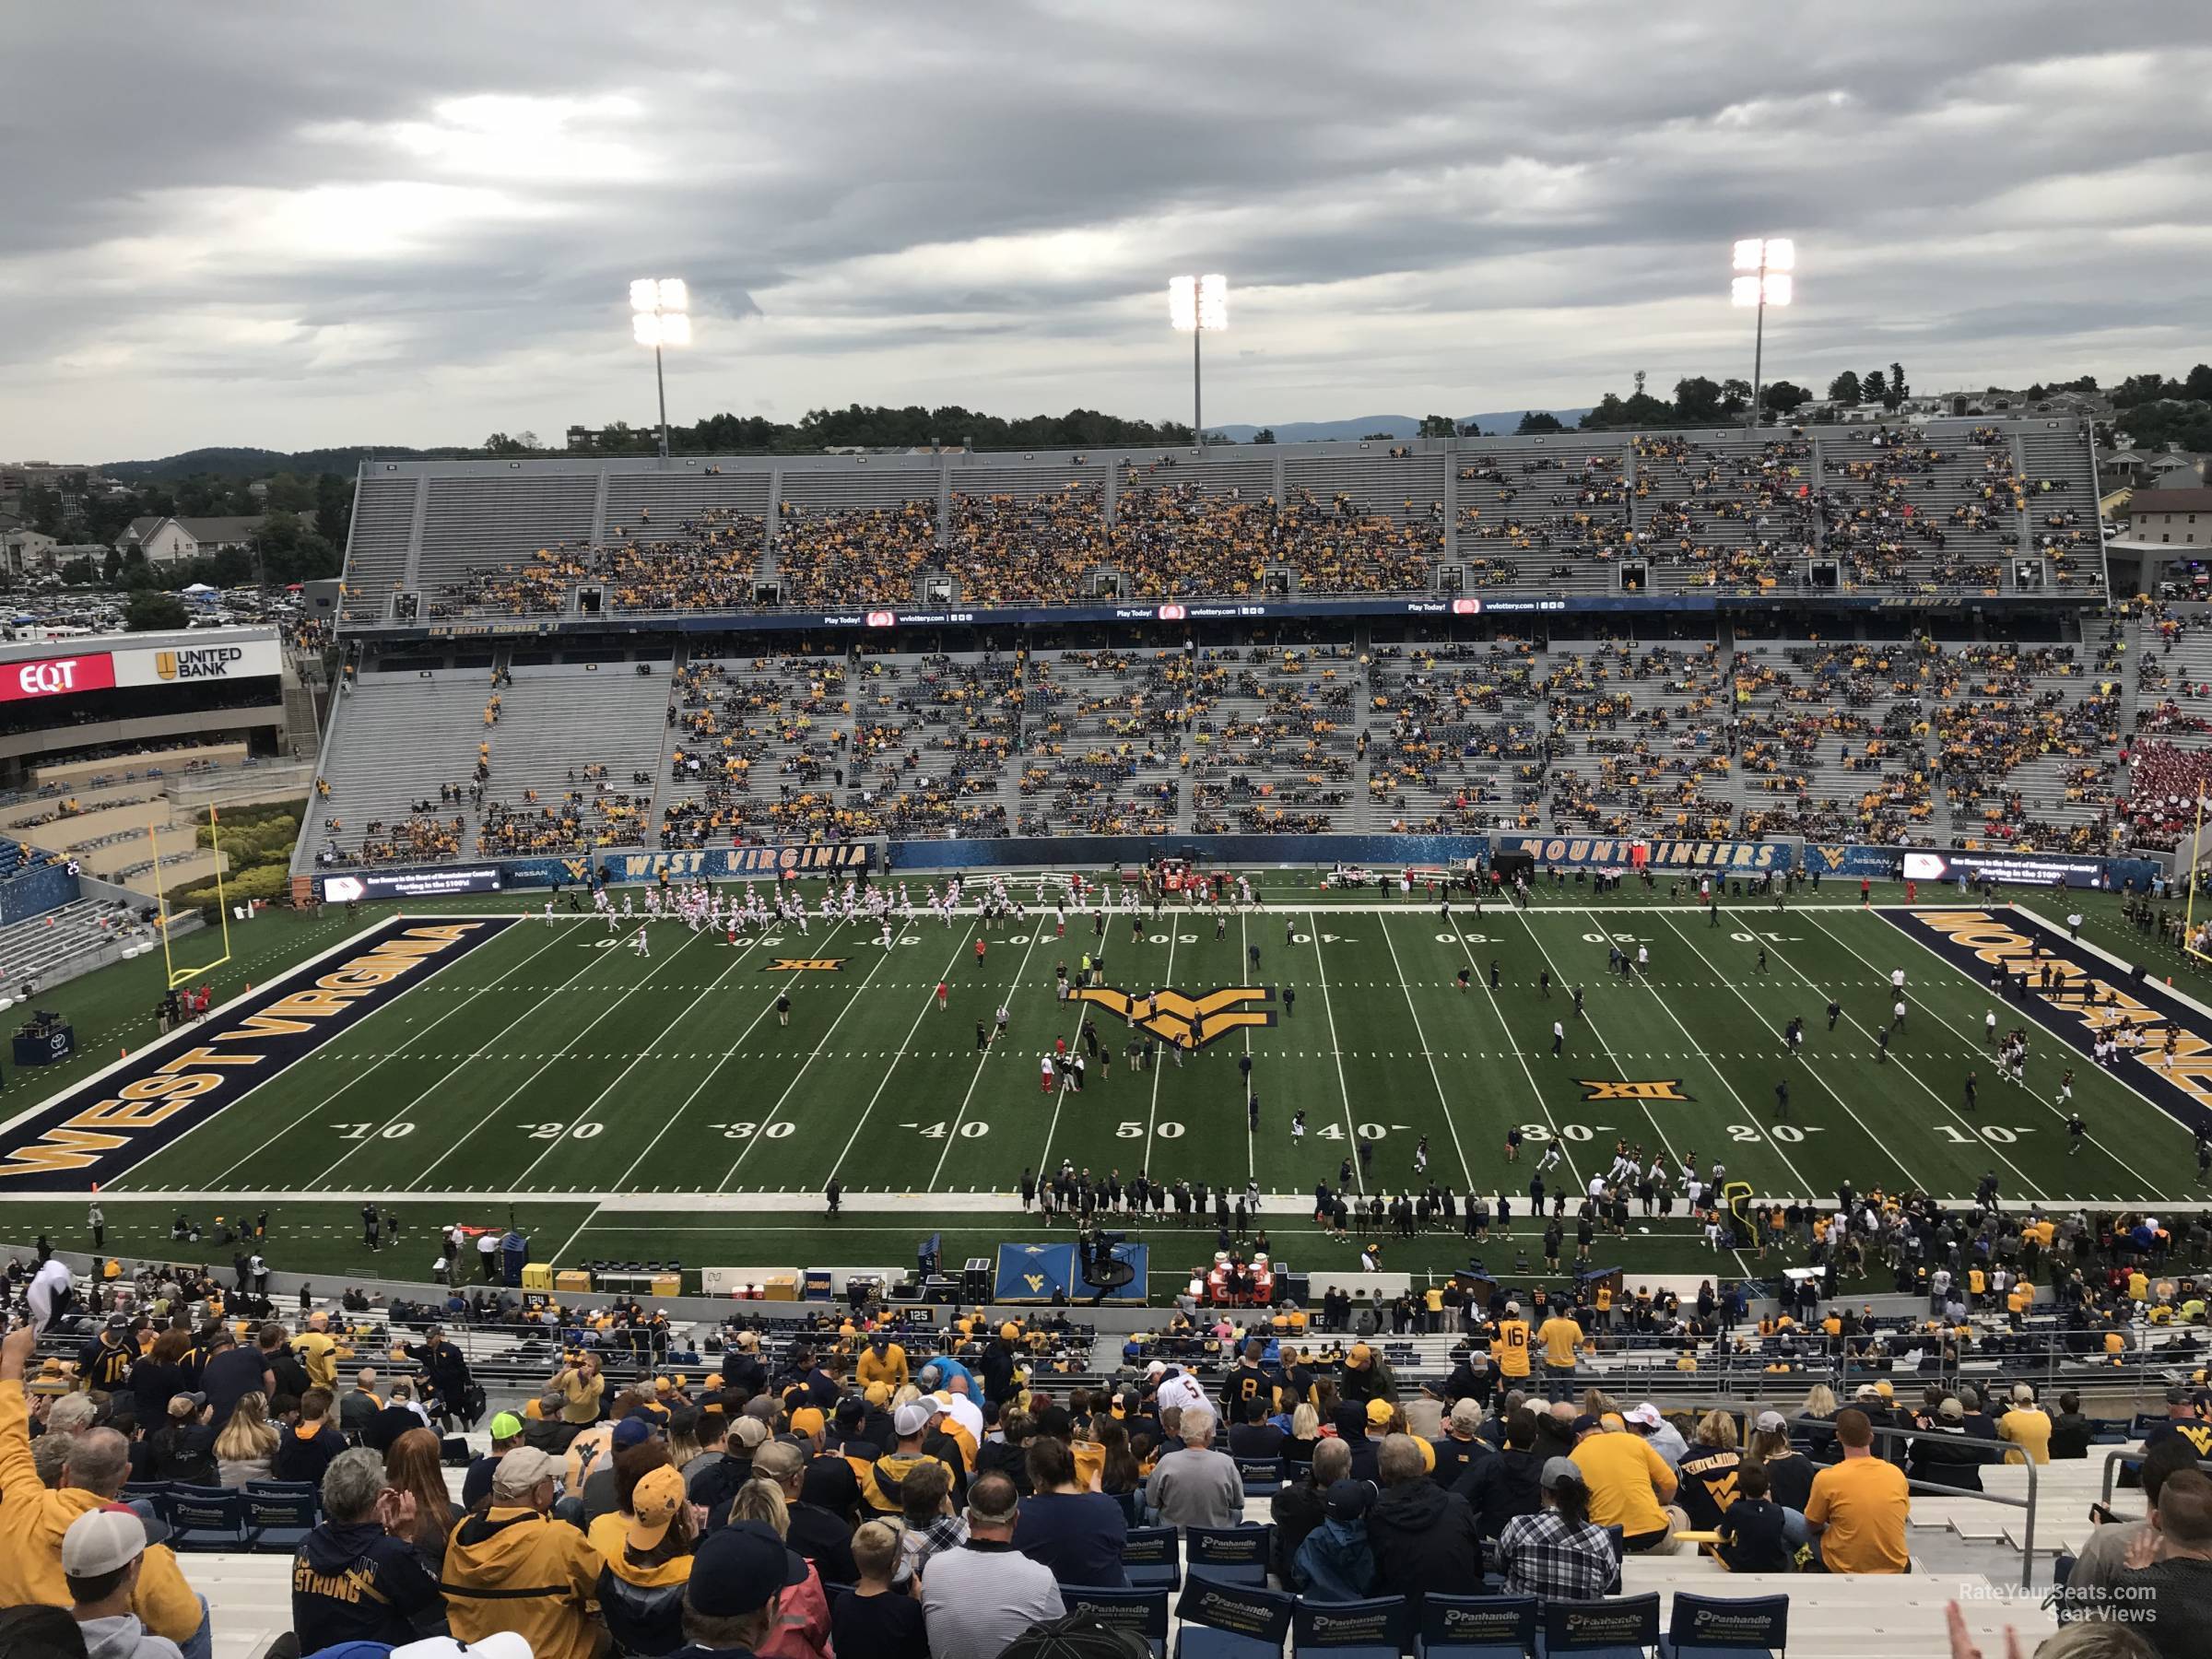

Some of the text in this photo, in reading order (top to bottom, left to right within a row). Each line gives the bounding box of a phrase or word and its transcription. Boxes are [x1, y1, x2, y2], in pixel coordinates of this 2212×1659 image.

[1117, 609, 1152, 618] Play Today!
[1191, 607, 1236, 617] wvlottery.com
[1408, 603, 1445, 612] Play Today!
[1486, 602, 1534, 611] wvlottery.com
[825, 617, 860, 626] Play Today!
[900, 614, 944, 623] wvlottery.com
[429, 628, 448, 636] IRA
[177, 648, 241, 665] UNITED
[19, 661, 76, 692] EQT
[179, 663, 228, 677] BANK
[626, 845, 868, 876] WEST VIRGINIA
[1853, 857, 1889, 865] NISSAN
[67, 861, 80, 876] 25
[514, 870, 547, 878] NISSAN
[394, 882, 424, 890] Starting
[0, 923, 487, 1177] WEST VIRGINIA
[340, 1122, 416, 1138] 10
[528, 1122, 605, 1138] 20
[724, 1122, 796, 1138] 30
[919, 1122, 990, 1138] 40
[1115, 1122, 1186, 1138] 50
[1316, 1123, 1387, 1140] 40
[1519, 1124, 1594, 1141] 30
[1726, 1124, 1805, 1142] 20
[1933, 1125, 2018, 1143] 10
[180, 1269, 194, 1279] 13
[527, 1295, 545, 1305] 124
[910, 1311, 928, 1321] 125
[1507, 1328, 1524, 1347] 16
[1241, 1378, 1258, 1401] 8
[1126, 1539, 1165, 1547] anhandle
[294, 1569, 361, 1604] STRONG
[1091, 1604, 1149, 1613] Panhandle
[1218, 1599, 1274, 1618] Panhandle
[1461, 1611, 1520, 1621] Panhandle
[1711, 1615, 1771, 1624] Panhandle
